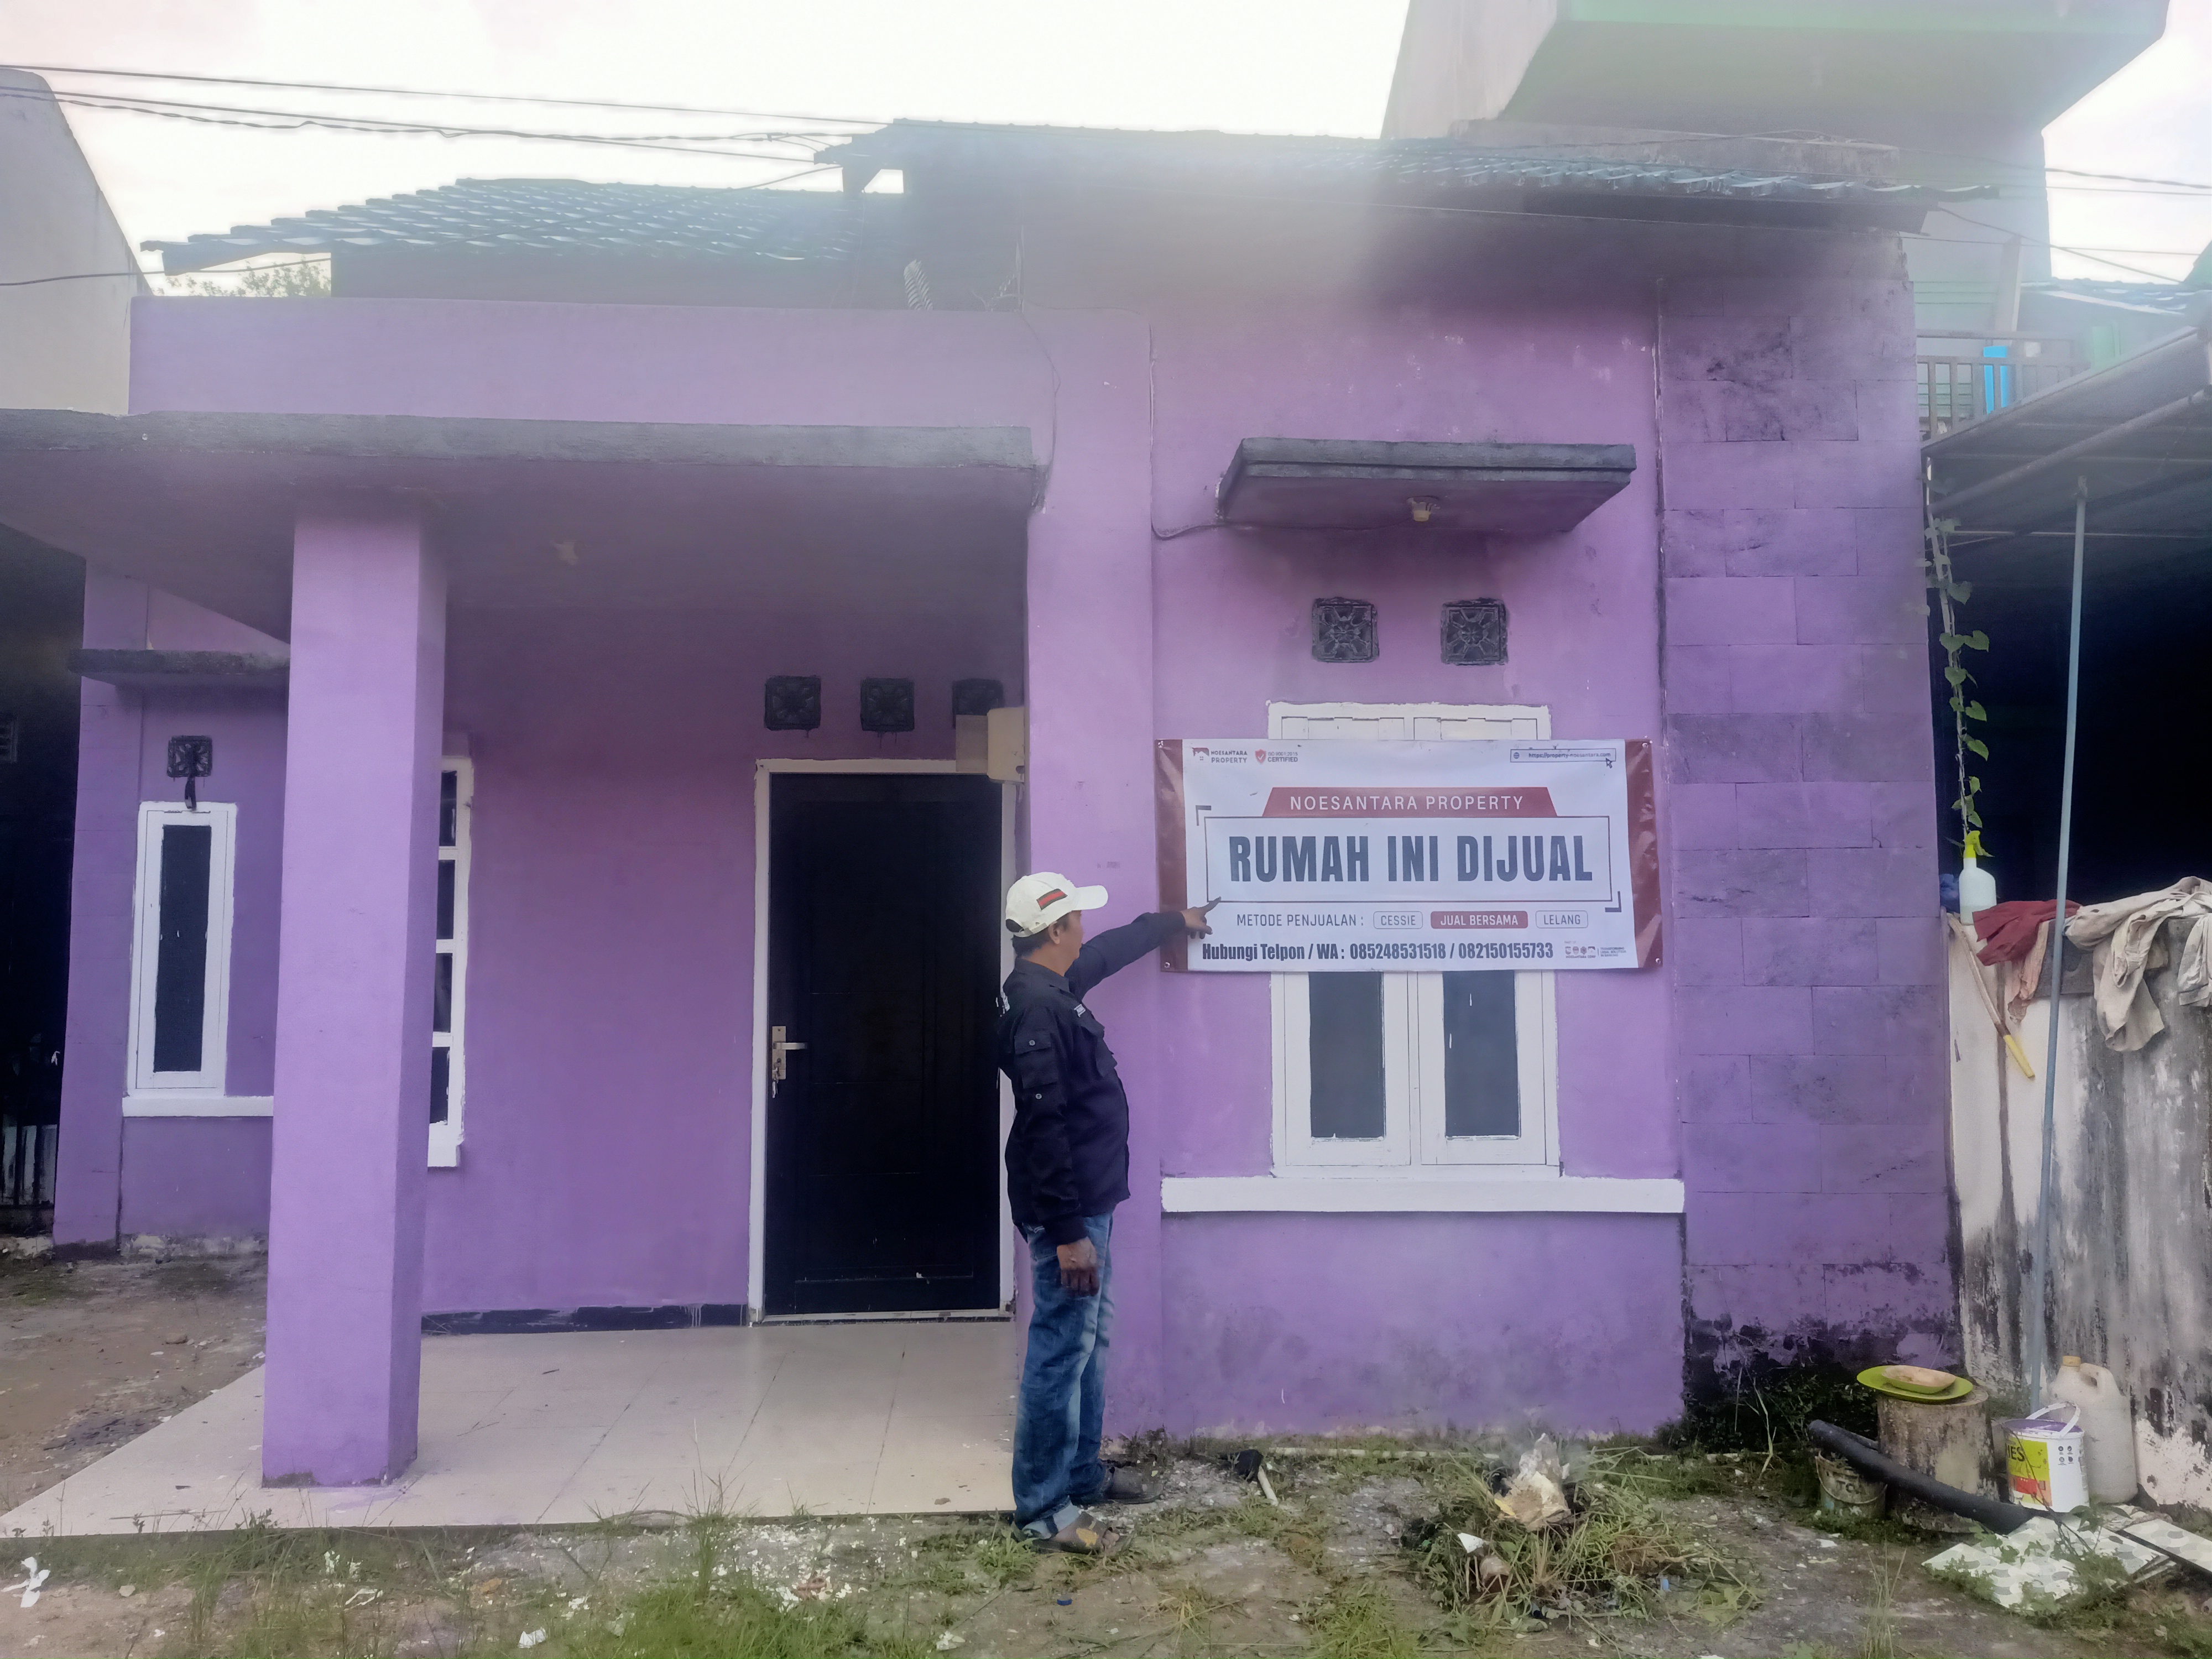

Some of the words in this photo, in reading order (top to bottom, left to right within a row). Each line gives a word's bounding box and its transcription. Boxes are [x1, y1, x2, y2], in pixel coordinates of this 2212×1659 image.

[1290, 795, 1418, 811] NOESANTARA
[1426, 795, 1524, 810] PROPERTY
[1229, 835, 1369, 882] RUMAH
[1387, 835, 1439, 882] INI
[1457, 835, 1593, 881] DIJUAL
[1237, 914, 1282, 927] METODE
[1287, 914, 1357, 926] PENJUALAN
[1380, 915, 1416, 926] CESSIE
[1440, 914, 1467, 926] JUAL
[1469, 914, 1519, 926] BERSAMA
[1543, 914, 1581, 925] LELANG
[1202, 943, 1258, 962] Hubungi
[1260, 943, 1305, 961] Telpon
[1308, 943, 1314, 959] /
[1350, 942, 1446, 959] 085248531518
[1449, 942, 1455, 958] /
[1458, 942, 1553, 958] 082150155733
